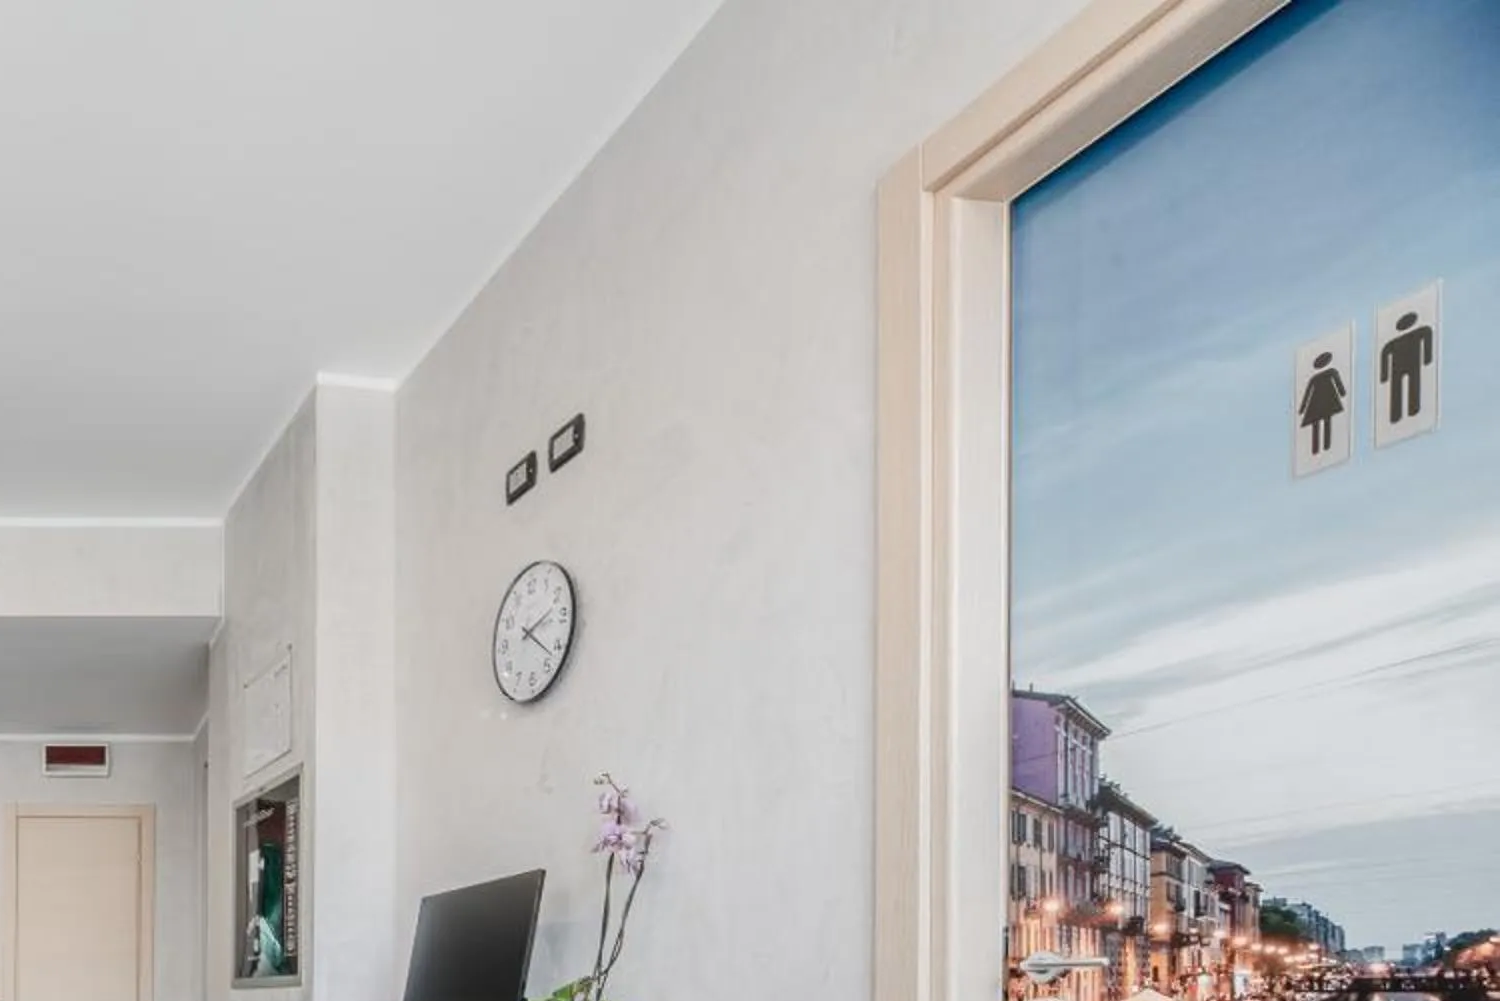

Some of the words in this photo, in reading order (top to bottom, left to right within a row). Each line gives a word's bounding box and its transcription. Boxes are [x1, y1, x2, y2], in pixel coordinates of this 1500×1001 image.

[553, 586, 562, 604] 2
[559, 606, 568, 624] 3
[502, 638, 509, 655] 9
[553, 639, 562, 652] 4
[544, 658, 552, 674] 5
[515, 671, 523, 686] 7
[528, 671, 538, 687] 6
